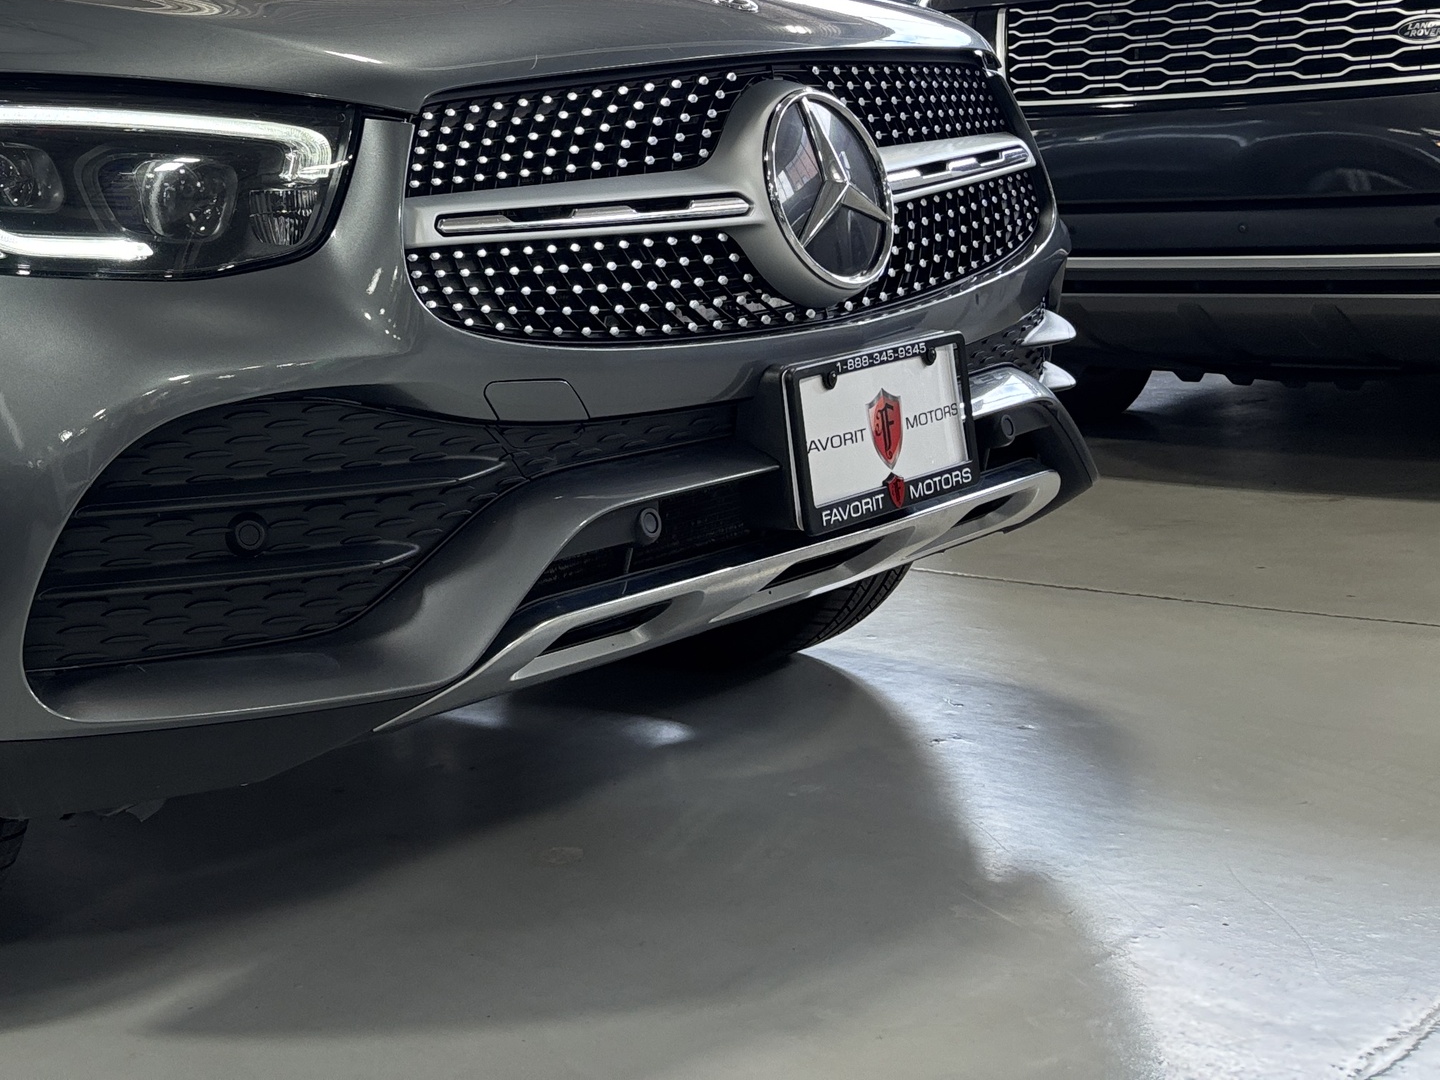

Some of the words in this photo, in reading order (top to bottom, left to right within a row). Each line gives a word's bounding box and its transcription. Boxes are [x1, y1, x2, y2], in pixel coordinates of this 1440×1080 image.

[836, 342, 927, 373] 1-888-345-9345
[807, 428, 867, 455] AVORIT
[905, 402, 959, 430] MOTORS
[821, 493, 885, 527] FAVORIT
[909, 467, 972, 500] MOTORS
